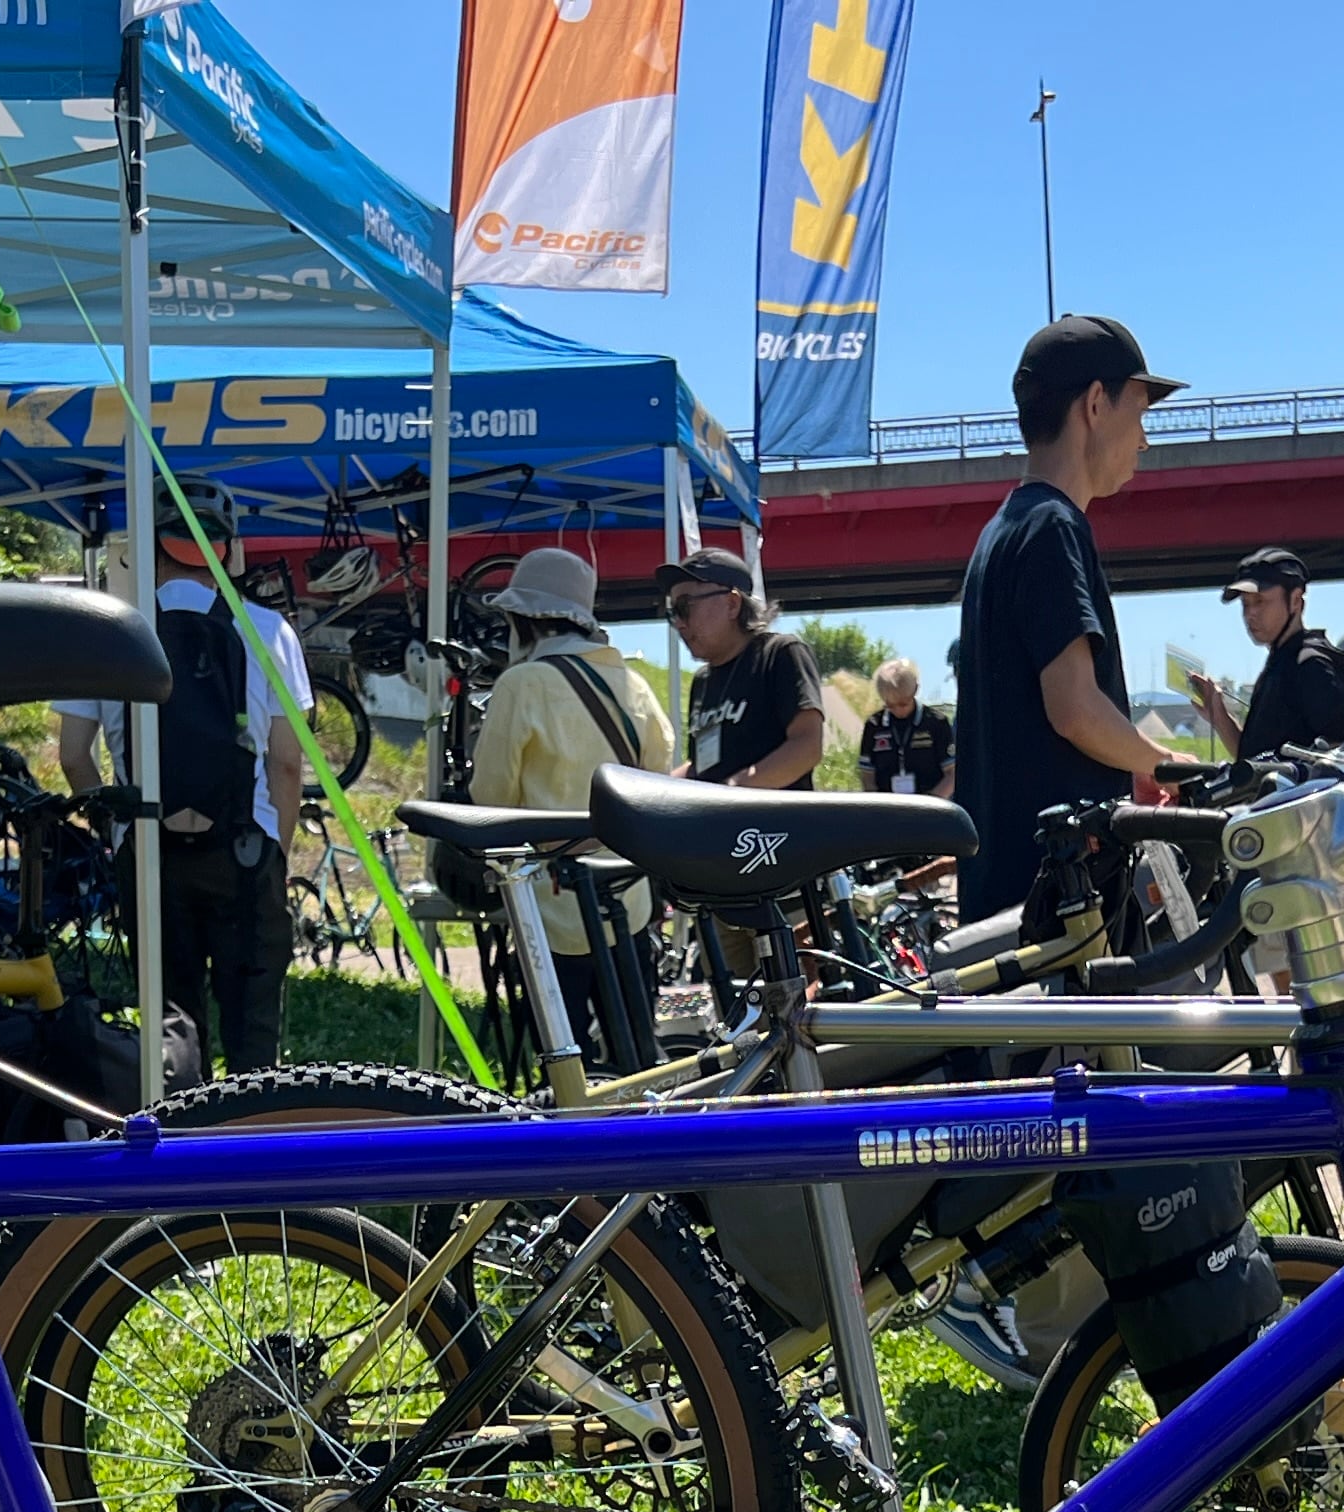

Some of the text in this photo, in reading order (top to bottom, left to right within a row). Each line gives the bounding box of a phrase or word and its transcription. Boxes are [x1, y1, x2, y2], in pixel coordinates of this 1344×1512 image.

[185, 25, 260, 132] Pacific
[511, 223, 646, 254] Pacific
[574, 257, 641, 271] Cycles
[757, 331, 868, 362] BICYCLES
[334, 406, 538, 443] bicycls.com
[730, 827, 789, 875] SX
[858, 1120, 1059, 1168] GRASSHOPPER
[1136, 1185, 1198, 1233] dom
[1206, 1243, 1238, 1273] dom
